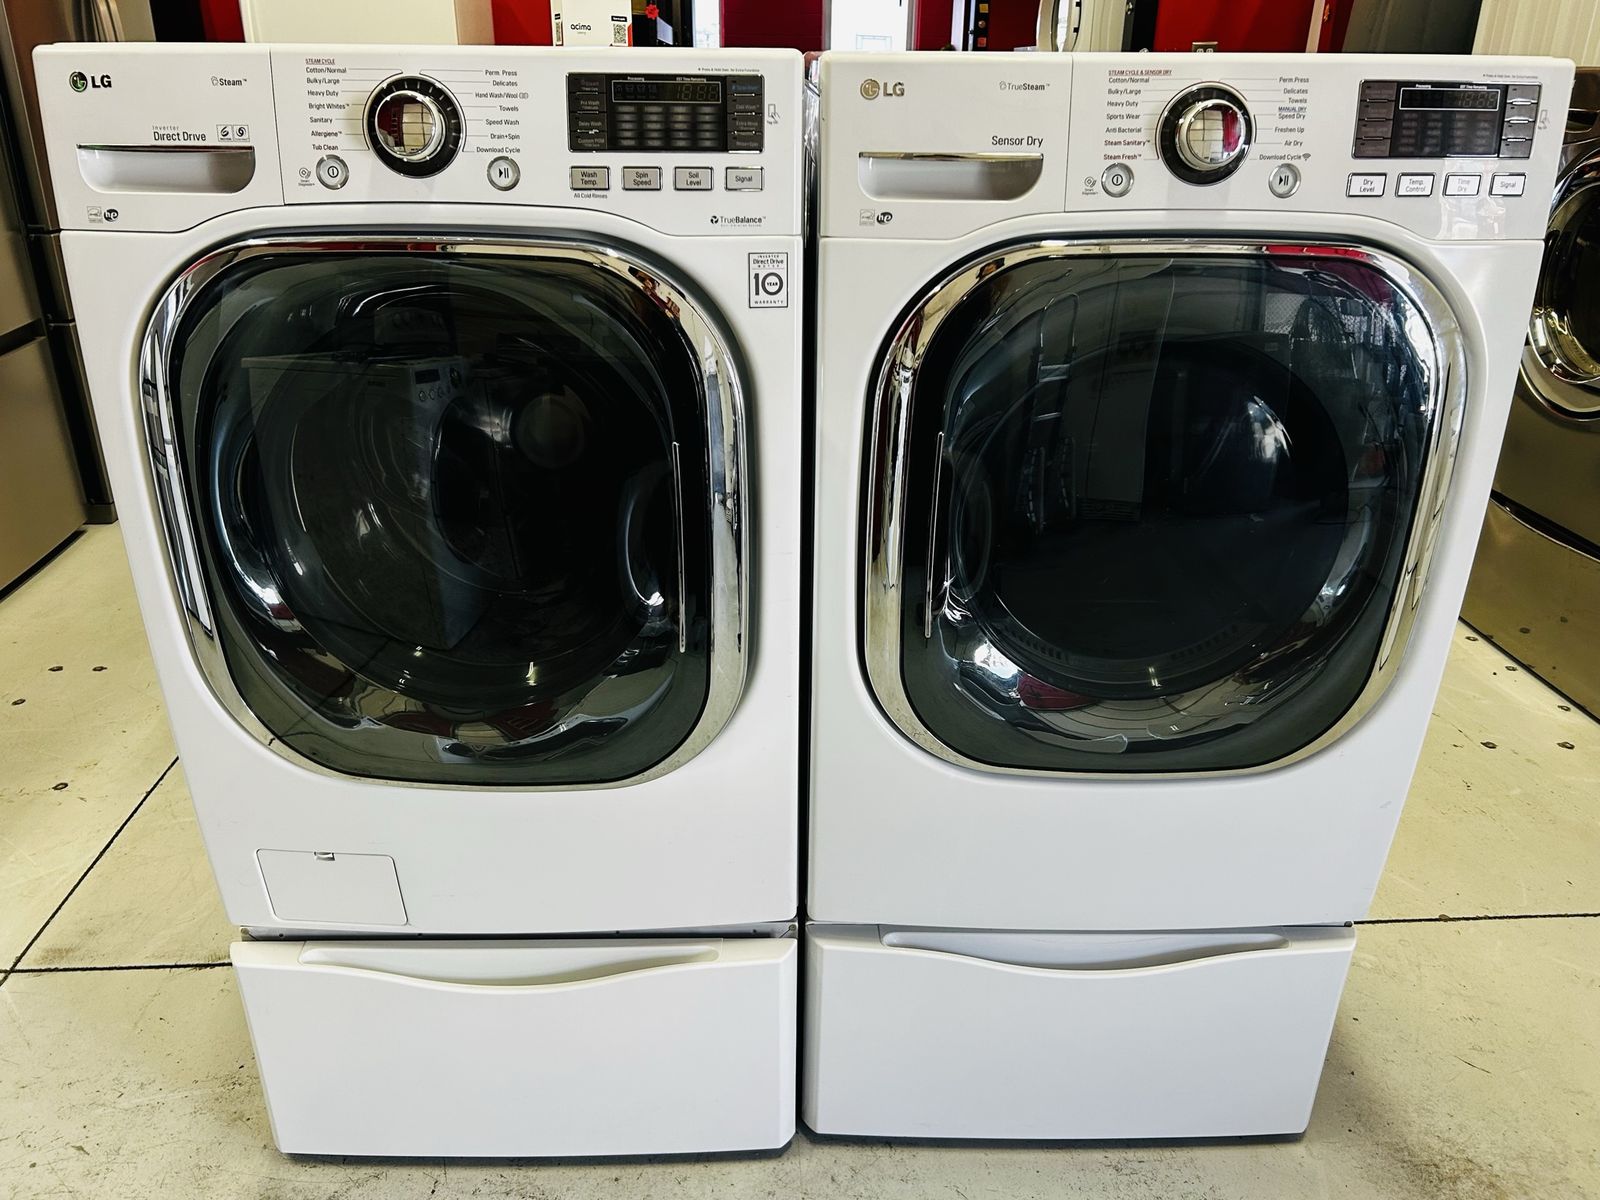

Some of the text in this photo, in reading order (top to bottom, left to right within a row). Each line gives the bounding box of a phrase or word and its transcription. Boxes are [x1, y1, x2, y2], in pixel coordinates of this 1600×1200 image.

[570, 22, 592, 30] acima
[90, 74, 112, 88] LG
[306, 77, 340, 85] Bulky/Large
[882, 82, 905, 97] LG
[153, 131, 206, 142] Direct Drive
[991, 135, 1044, 148] Sensor Dry
[635, 172, 649, 180] Spin
[735, 175, 753, 183] Signal
[753, 272, 784, 296] 10
